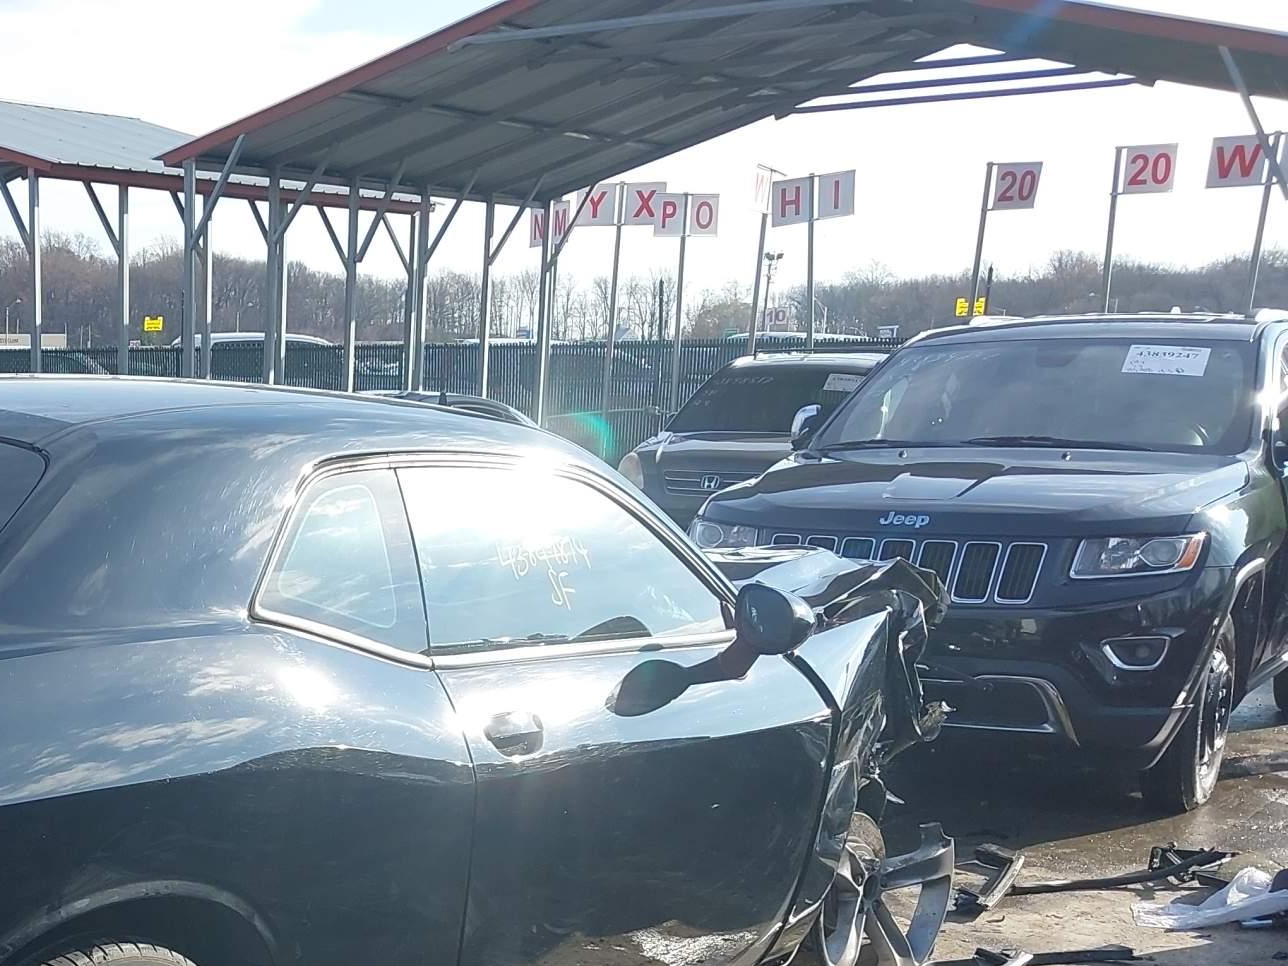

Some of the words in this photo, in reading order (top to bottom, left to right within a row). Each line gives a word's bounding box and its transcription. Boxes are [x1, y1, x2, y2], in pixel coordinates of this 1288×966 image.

[1128, 153, 1172, 186] 20
[1216, 144, 1261, 179] W
[833, 180, 840, 210] I
[998, 170, 1037, 203] 20
[588, 191, 608, 219] Y
[633, 190, 657, 218] X
[662, 201, 677, 229] P
[696, 201, 714, 230] O
[781, 186, 801, 218] H
[534, 213, 544, 240] N
[554, 208, 567, 237] M
[767, 308, 787, 323] 10
[879, 511, 930, 529] Jeep
